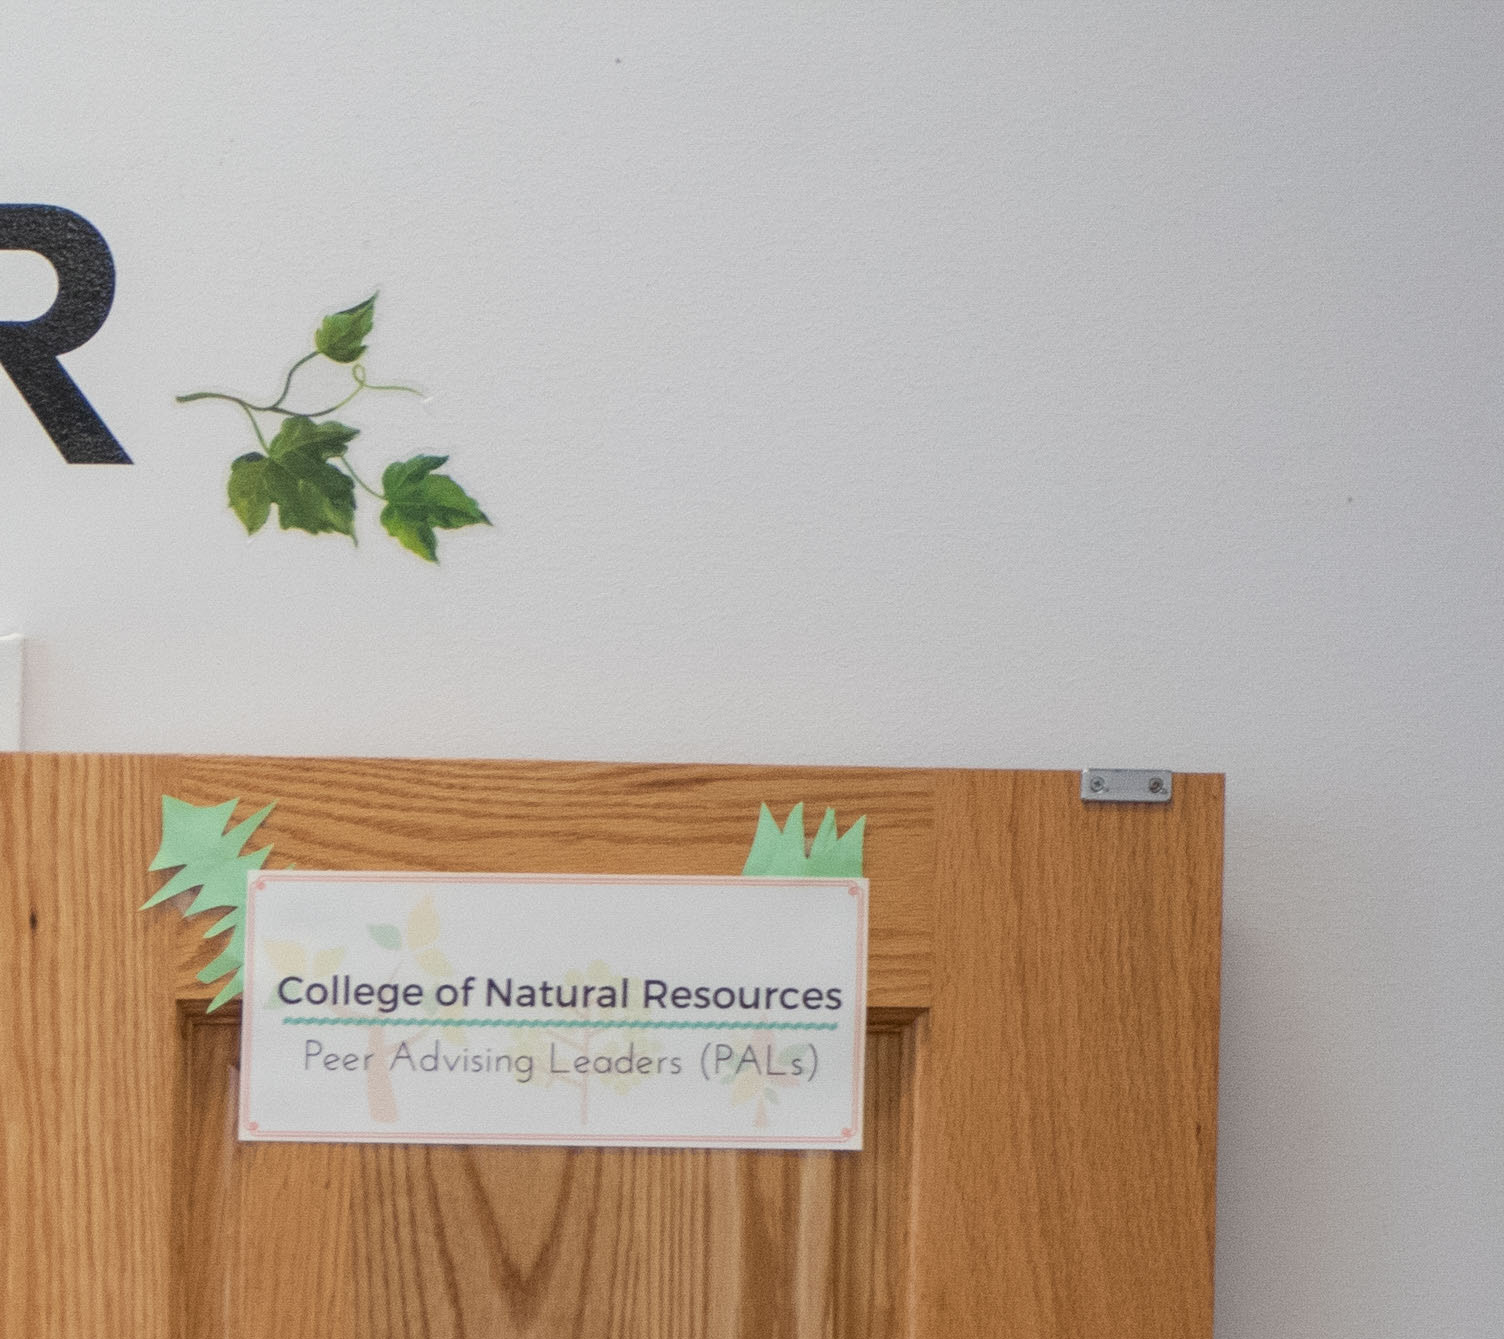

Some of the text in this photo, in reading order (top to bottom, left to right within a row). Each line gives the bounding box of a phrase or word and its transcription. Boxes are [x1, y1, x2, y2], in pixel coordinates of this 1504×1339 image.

[278, 975, 842, 1013] College of Natural Resources
[304, 1040, 818, 1083] Peer Advising Leaders (PALs)
